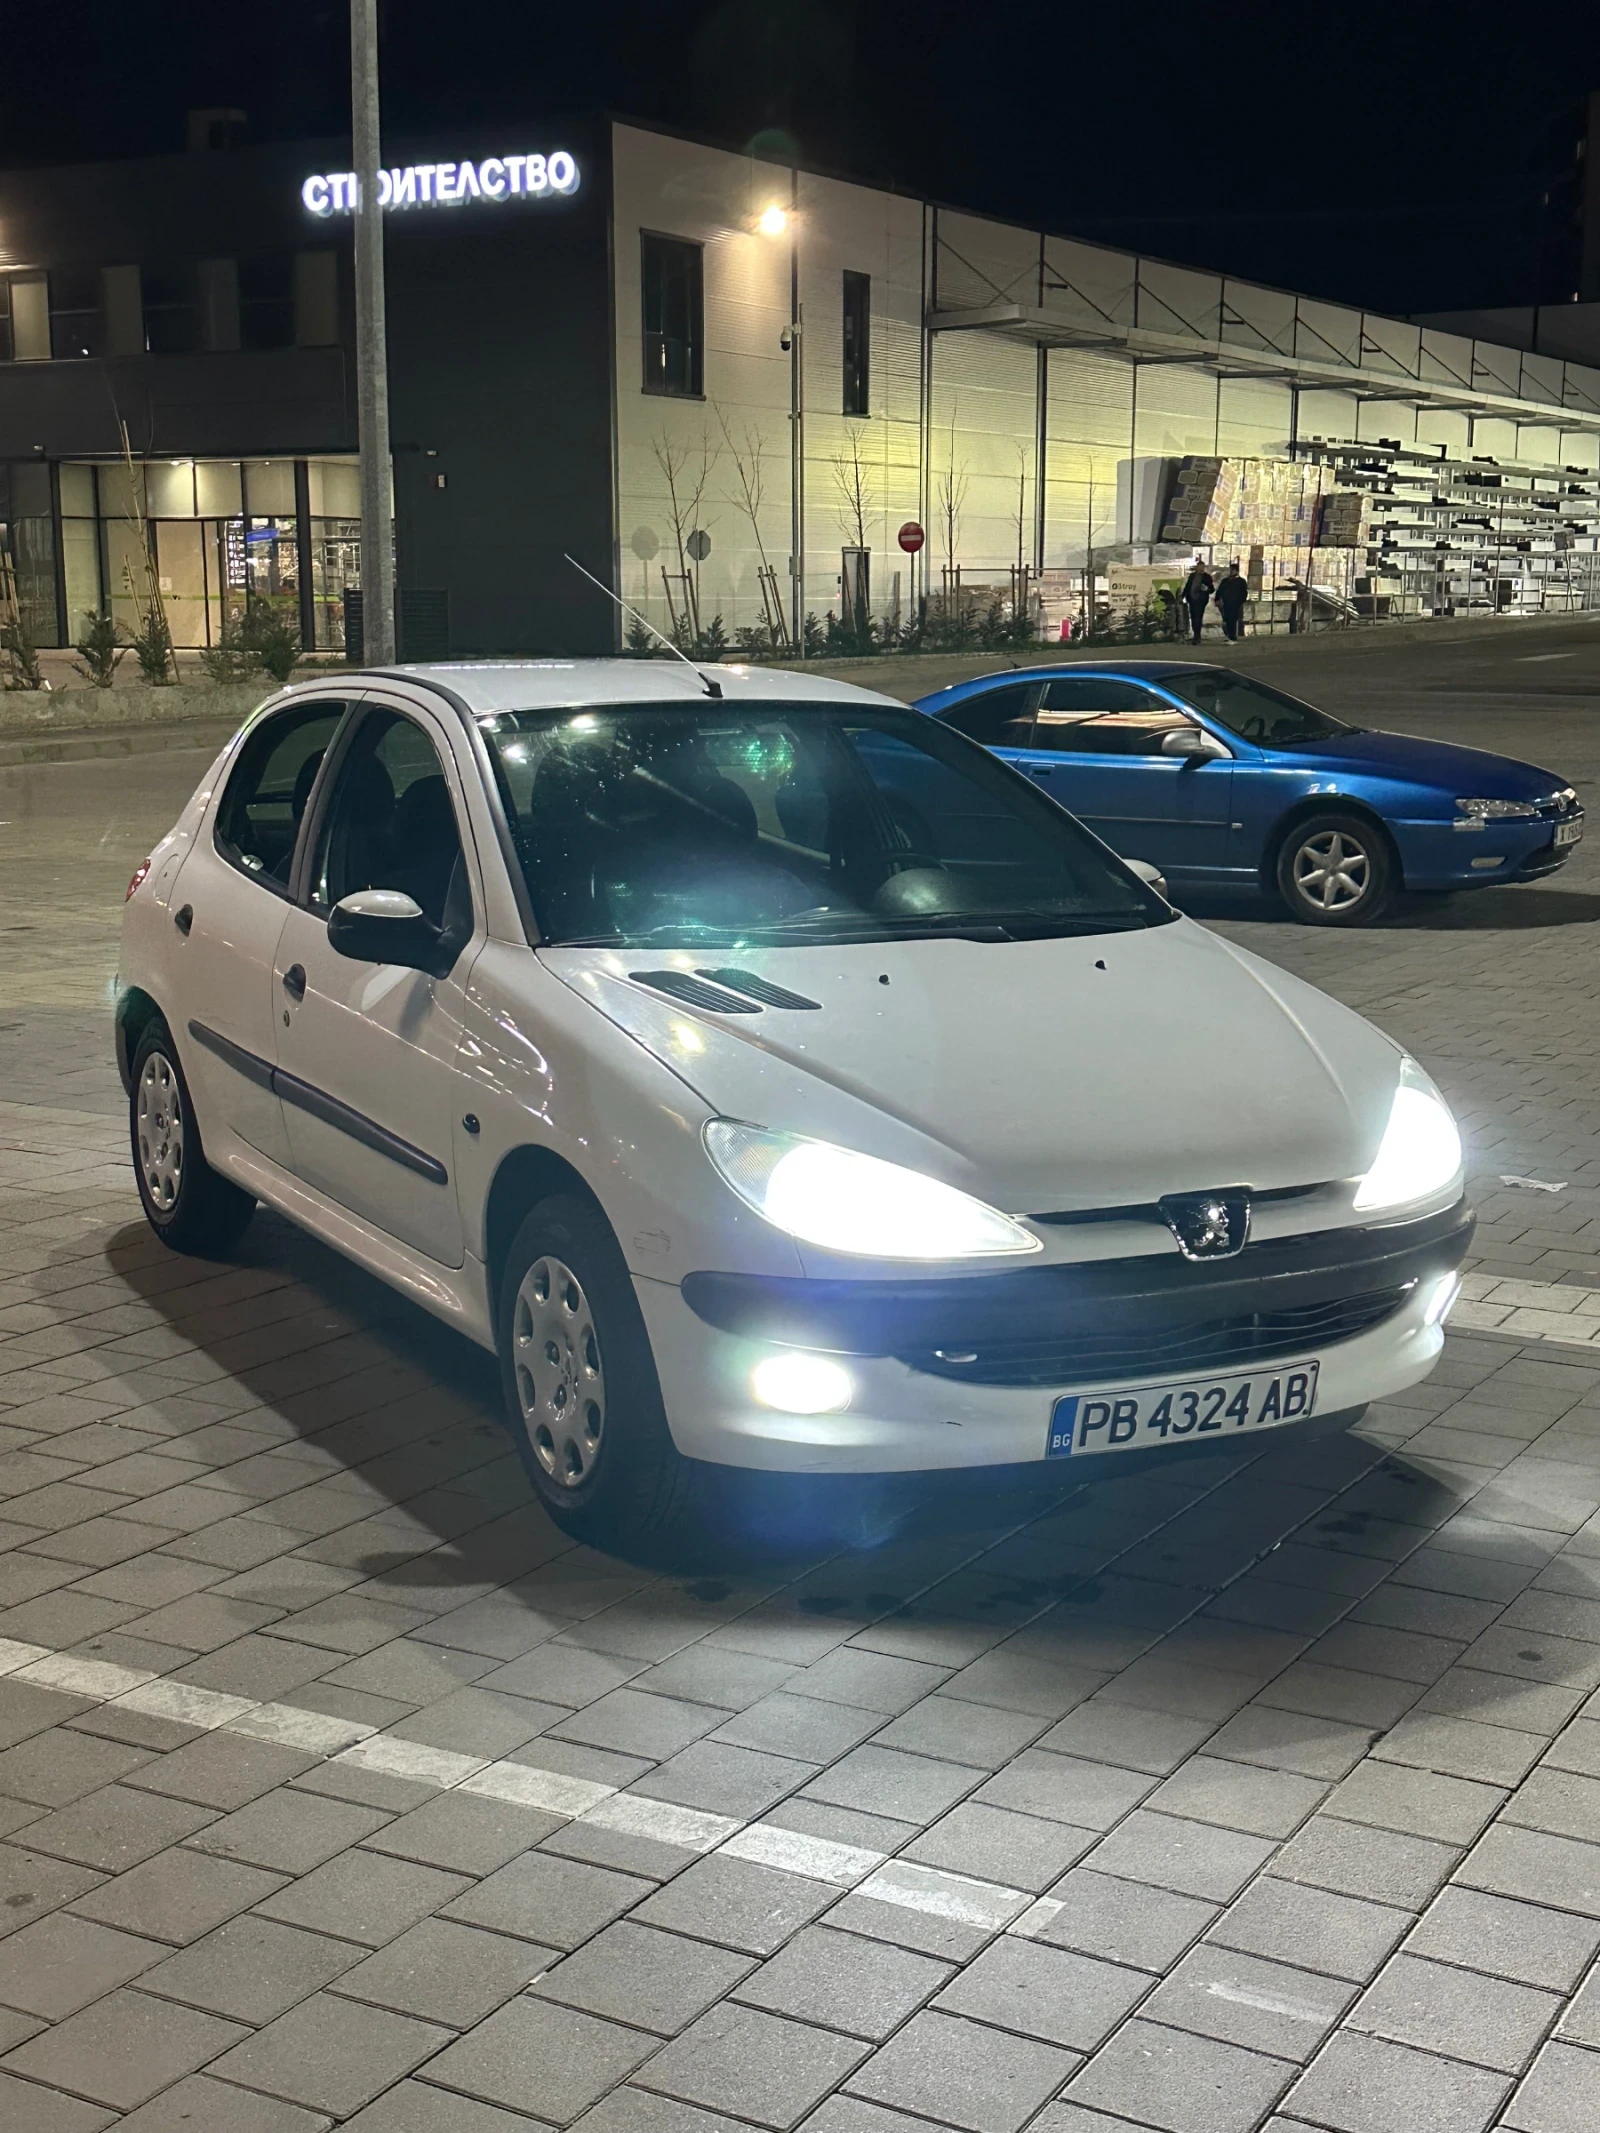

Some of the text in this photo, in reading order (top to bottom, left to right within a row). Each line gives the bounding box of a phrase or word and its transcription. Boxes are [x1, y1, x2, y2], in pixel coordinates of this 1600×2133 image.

[1078, 1372, 1309, 1448] PB 4324 AB
[1052, 1433, 1071, 1448] BG
